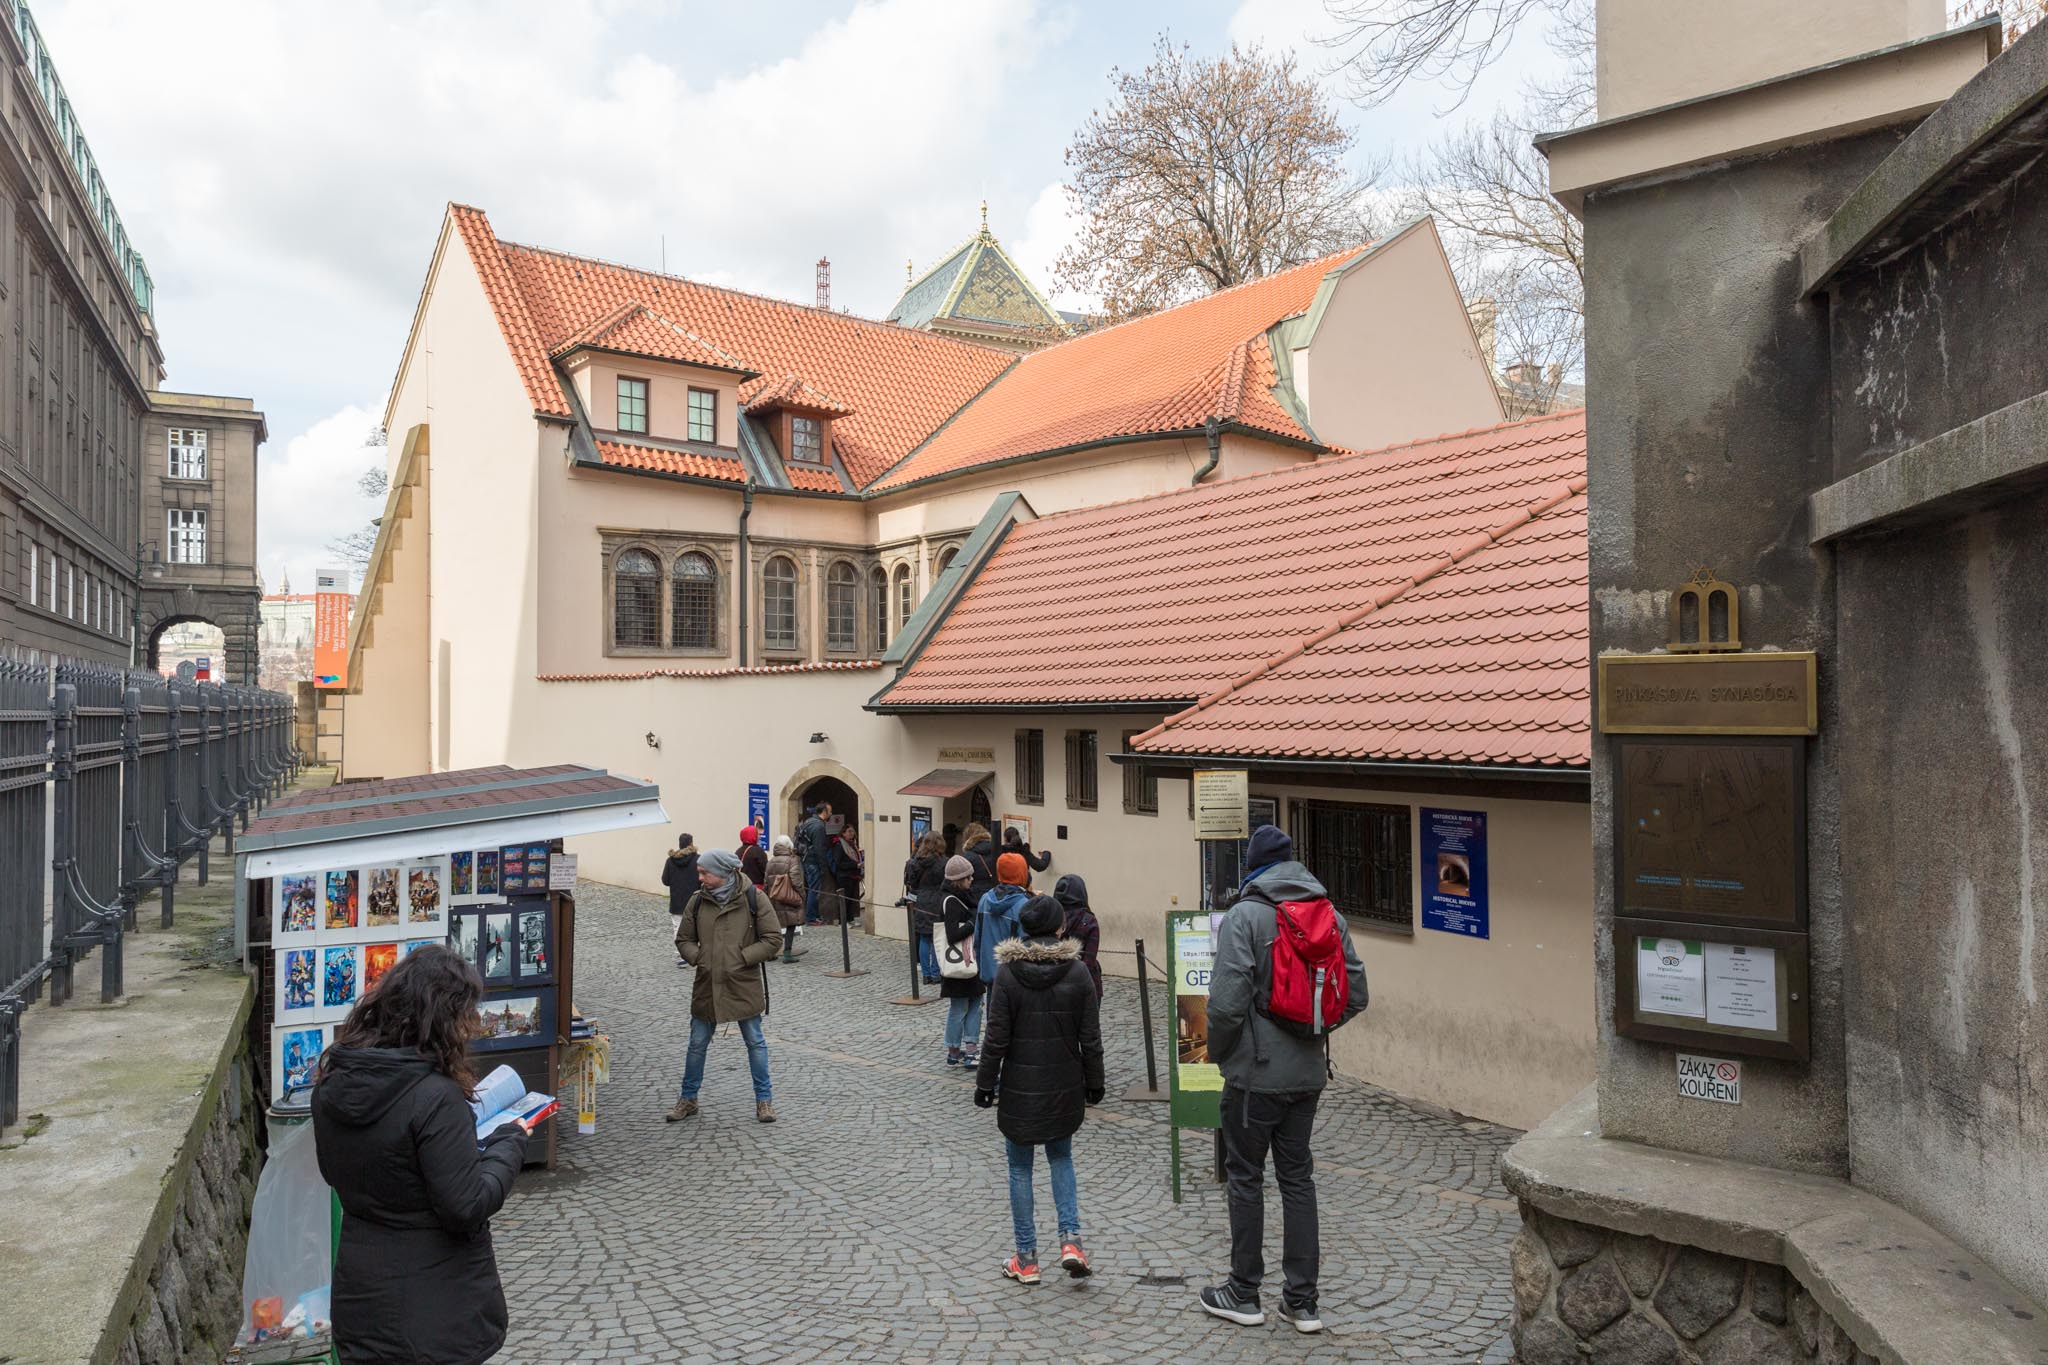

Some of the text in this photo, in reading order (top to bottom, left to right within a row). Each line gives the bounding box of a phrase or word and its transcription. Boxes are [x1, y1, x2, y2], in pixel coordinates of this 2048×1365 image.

[1615, 683, 1797, 703] PINKASOVA SYNAGÓGA
[1433, 895, 1457, 904] HISTORICAL
[1186, 969, 1214, 986] GE
[1679, 1057, 1716, 1080] ZÁKAZ
[1679, 1077, 1738, 1102] KOUŘENÍ
